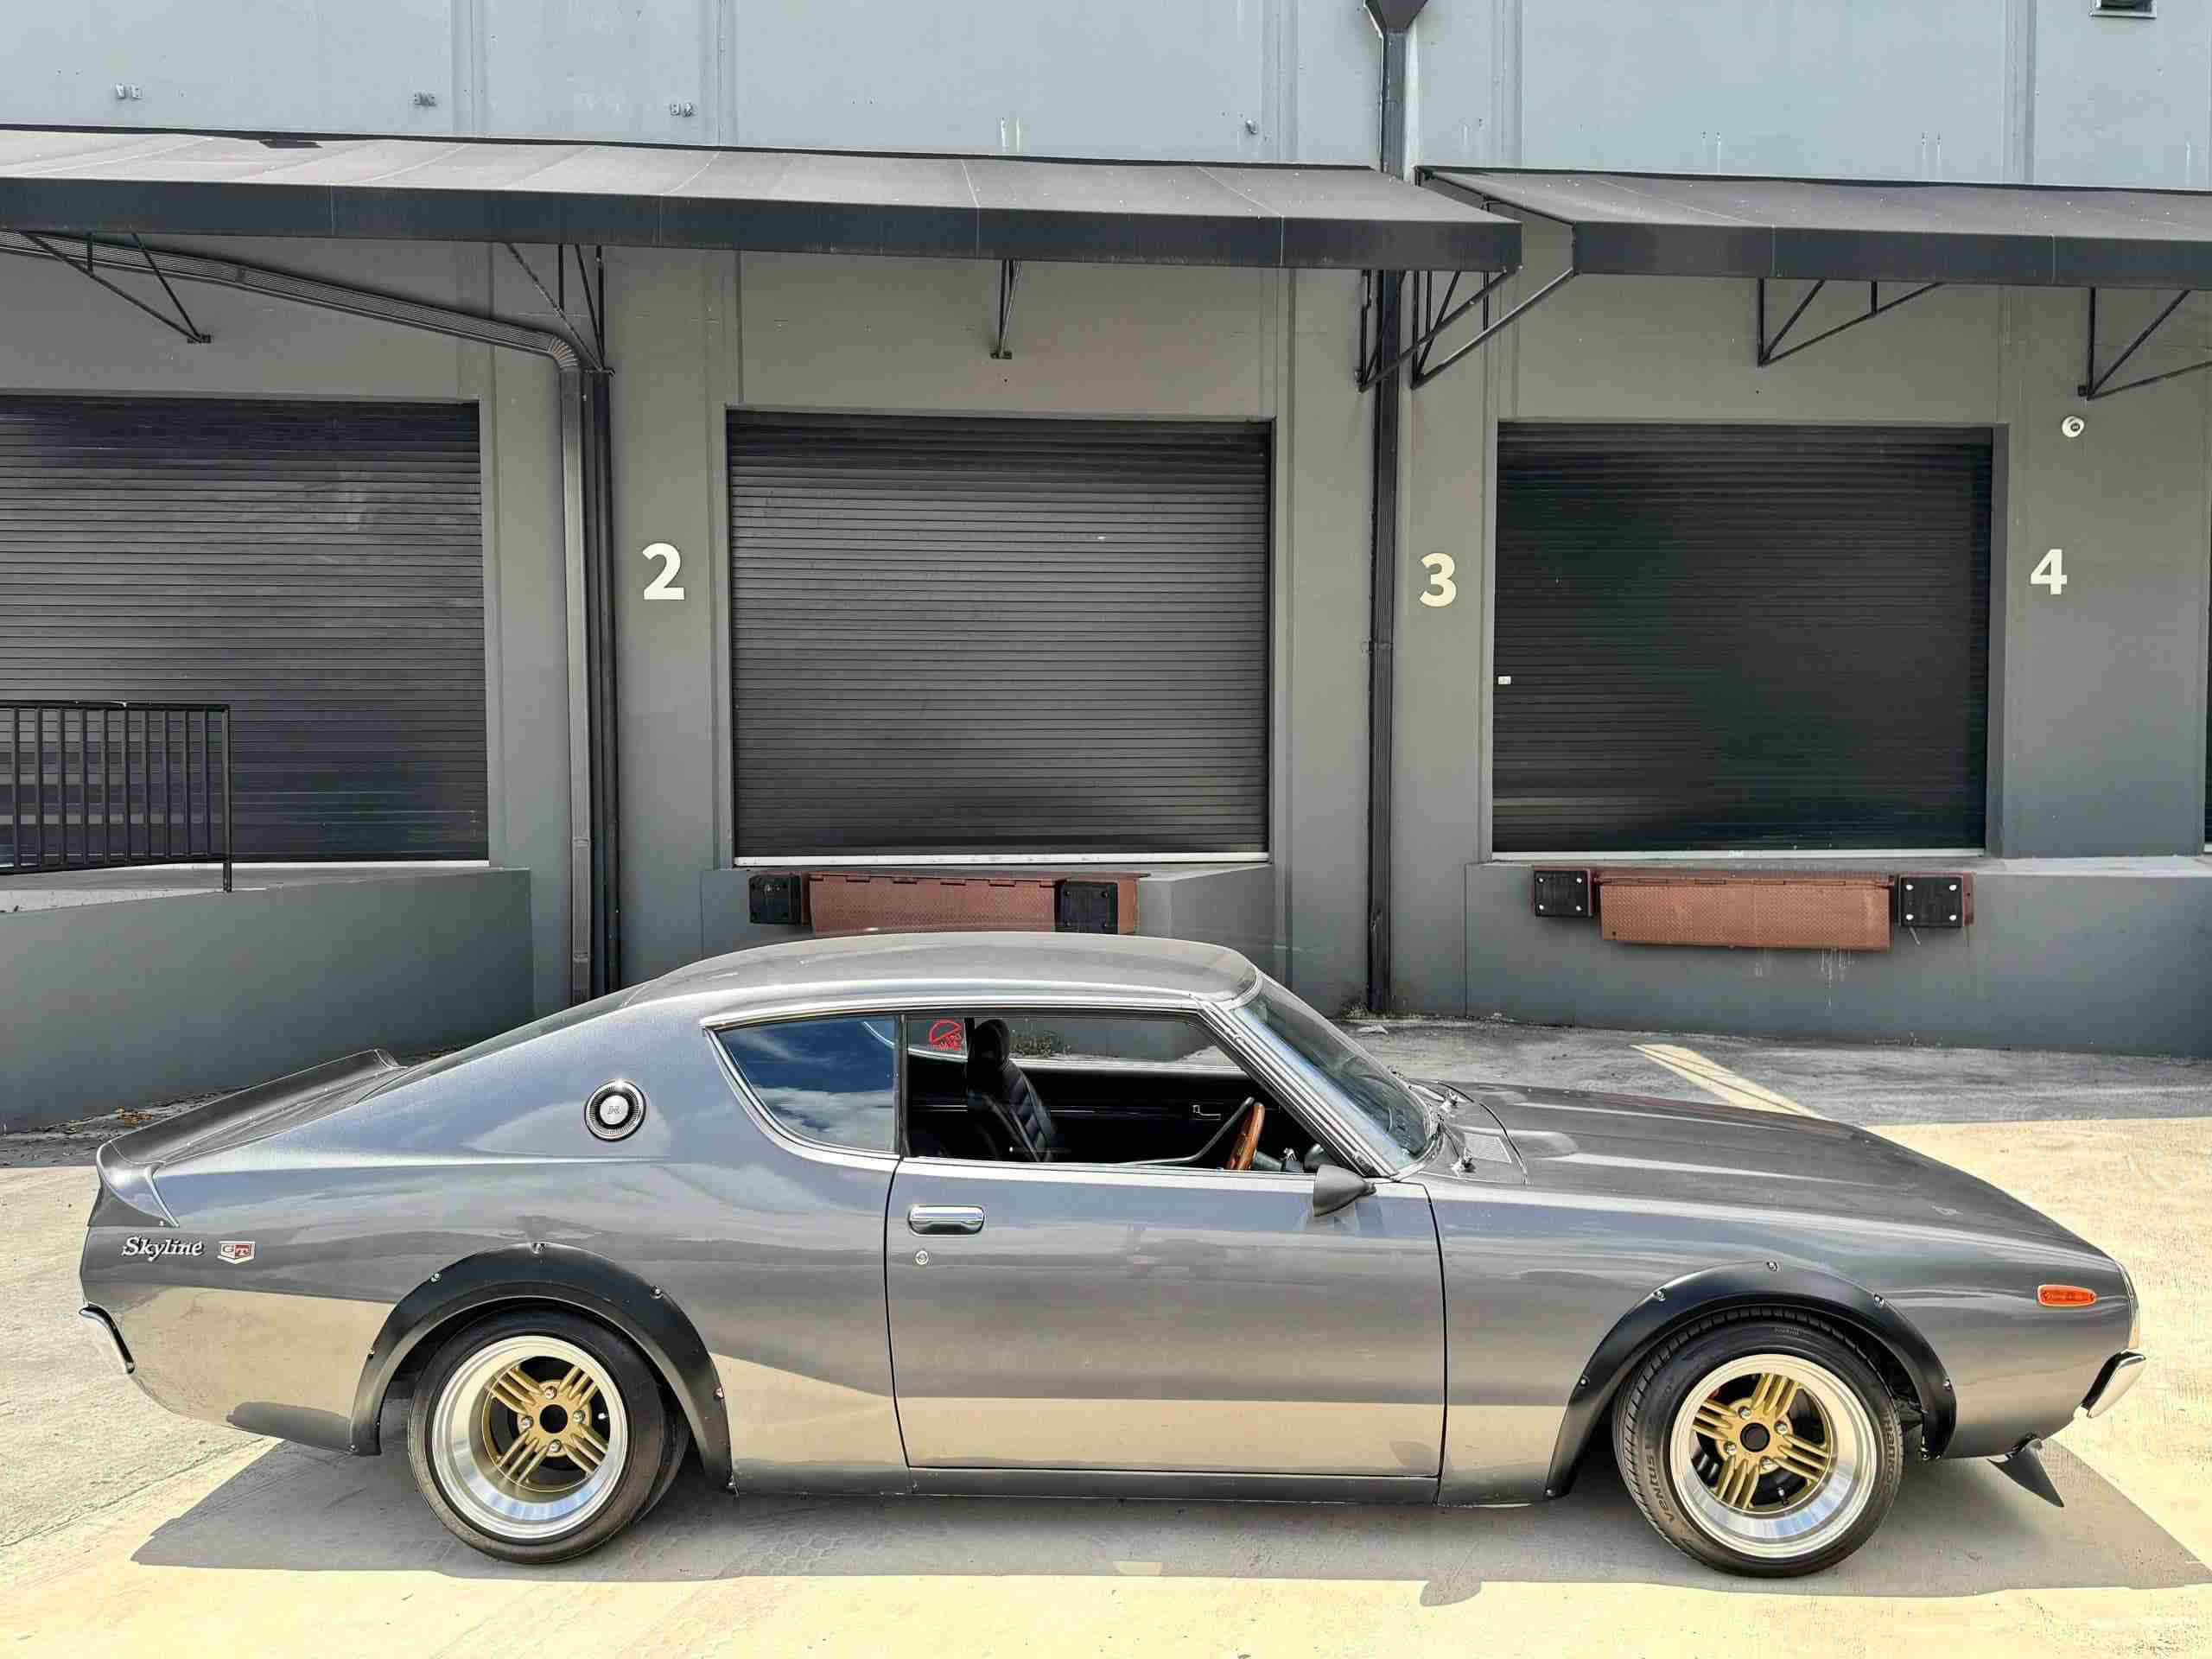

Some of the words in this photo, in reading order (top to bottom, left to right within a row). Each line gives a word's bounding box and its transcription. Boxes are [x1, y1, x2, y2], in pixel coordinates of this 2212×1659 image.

[642, 542, 685, 601] 2
[1419, 552, 1457, 607] 3
[2030, 549, 2068, 595] 4
[121, 1236, 204, 1262] Skyline
[219, 1243, 251, 1260] GT
